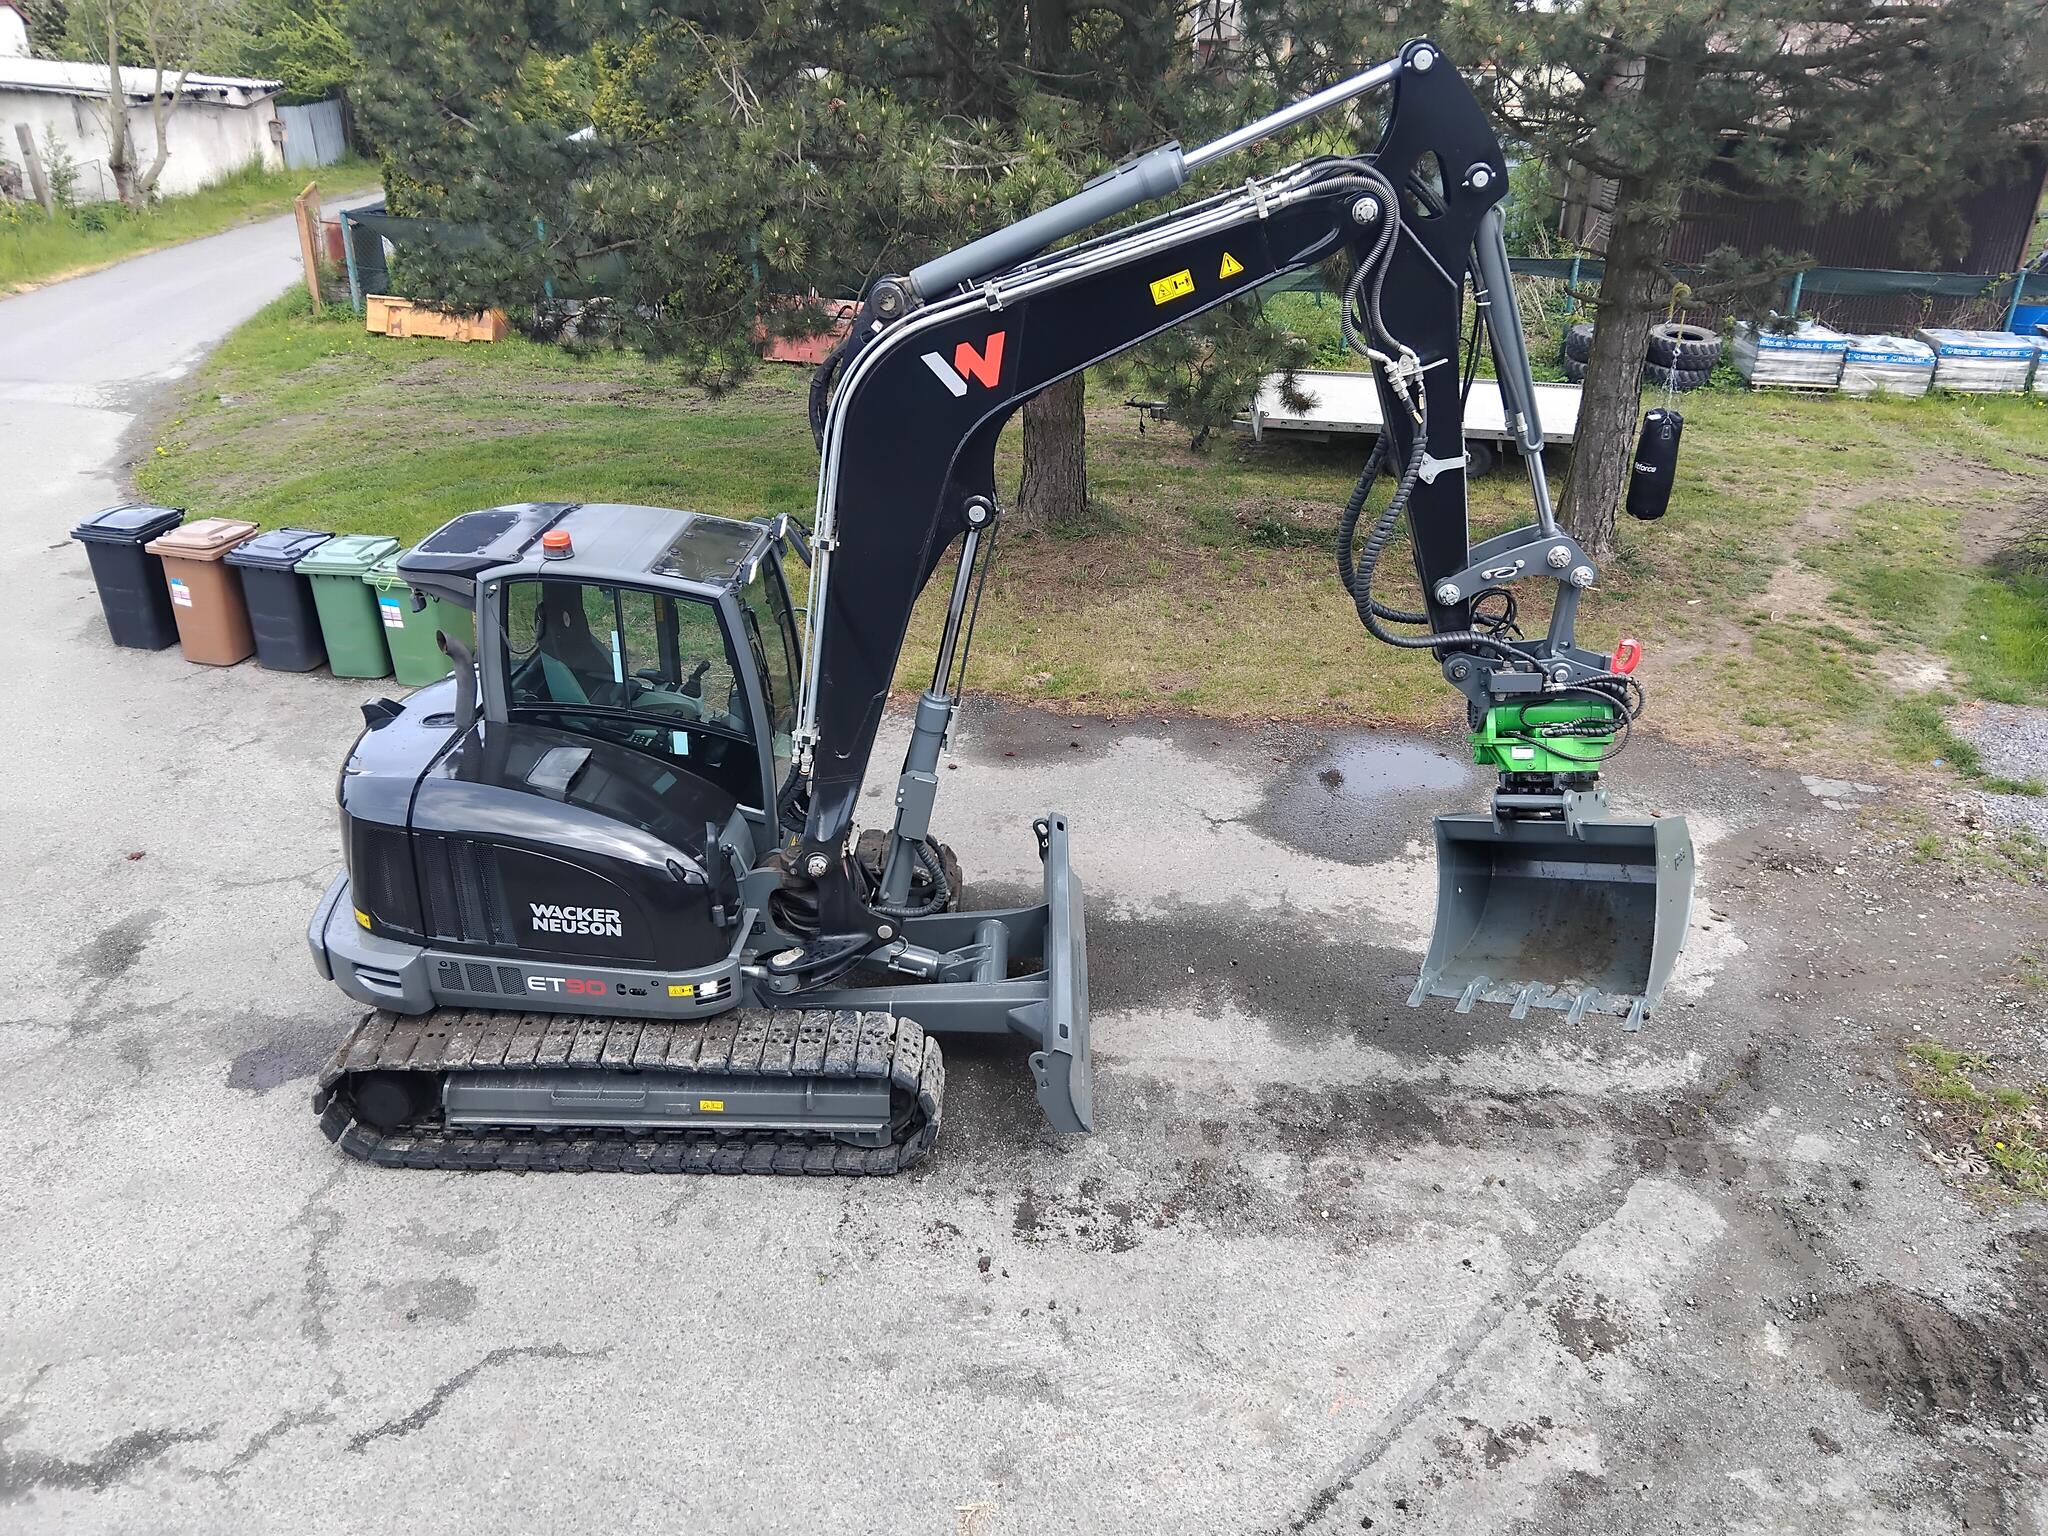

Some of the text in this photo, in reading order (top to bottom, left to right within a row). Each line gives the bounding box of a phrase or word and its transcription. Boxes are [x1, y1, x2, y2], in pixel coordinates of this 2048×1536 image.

[529, 903, 622, 923] WACKER
[532, 917, 622, 937] NEUSON
[527, 976, 607, 996] ET90
